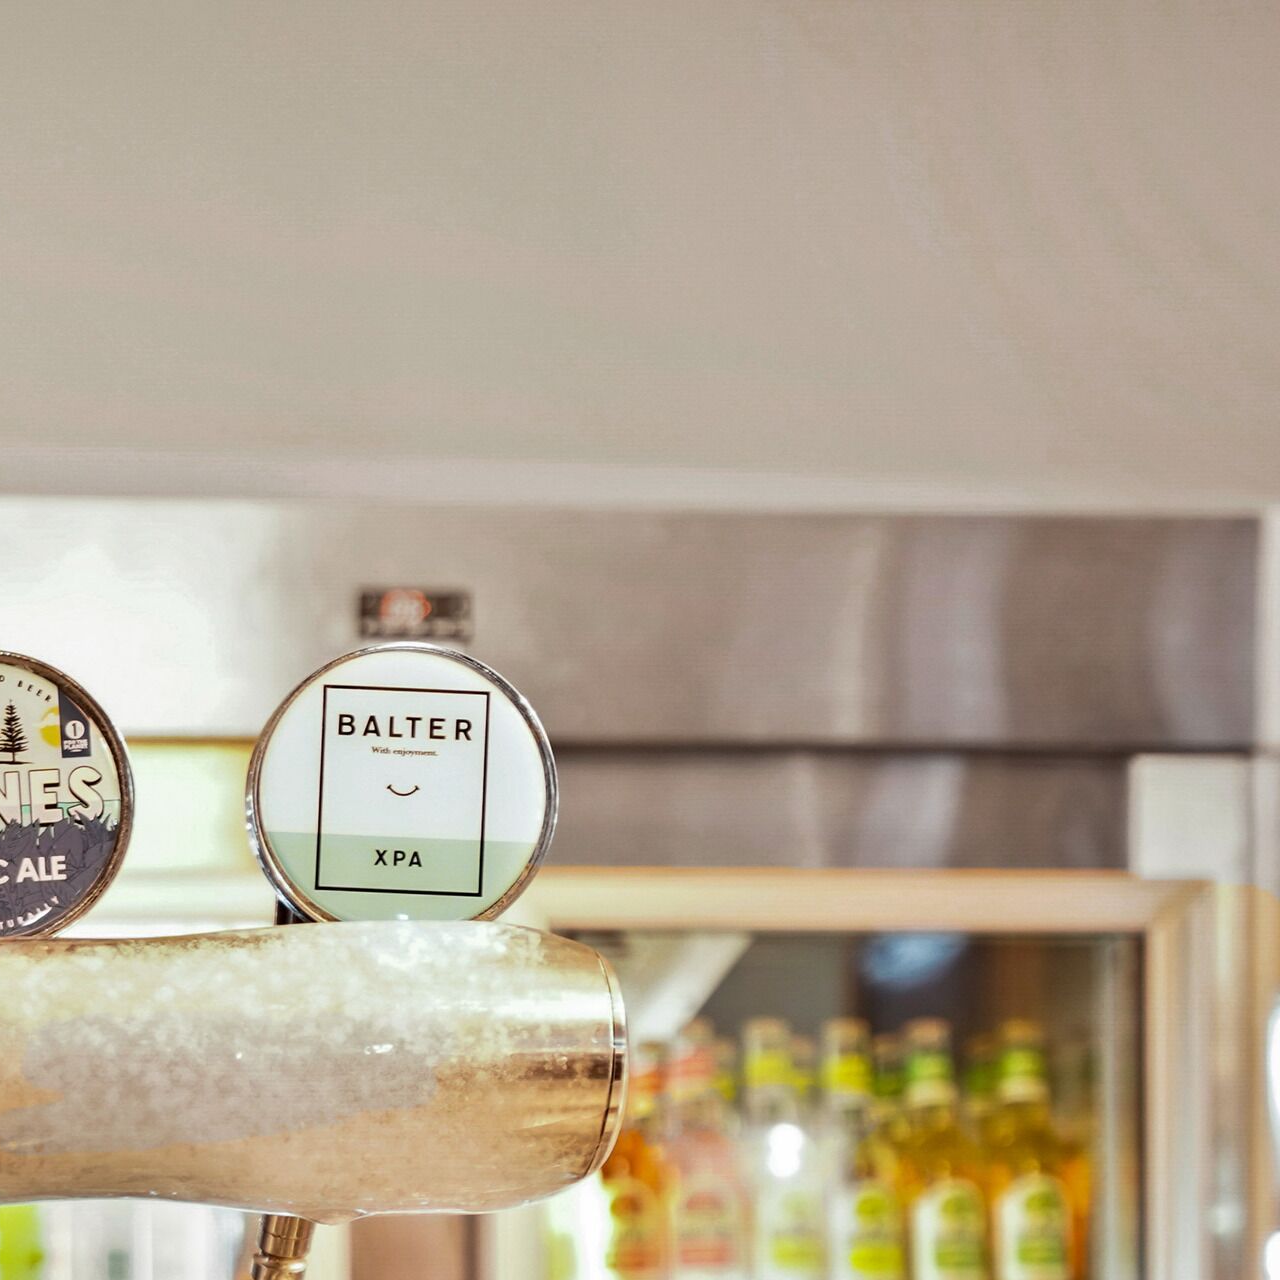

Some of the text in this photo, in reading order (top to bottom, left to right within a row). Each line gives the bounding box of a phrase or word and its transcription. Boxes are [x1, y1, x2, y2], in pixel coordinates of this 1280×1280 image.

[17, 680, 52, 703] BEER
[337, 714, 474, 741] BALTER
[16, 855, 68, 883] ALE
[373, 849, 424, 868] XPA
